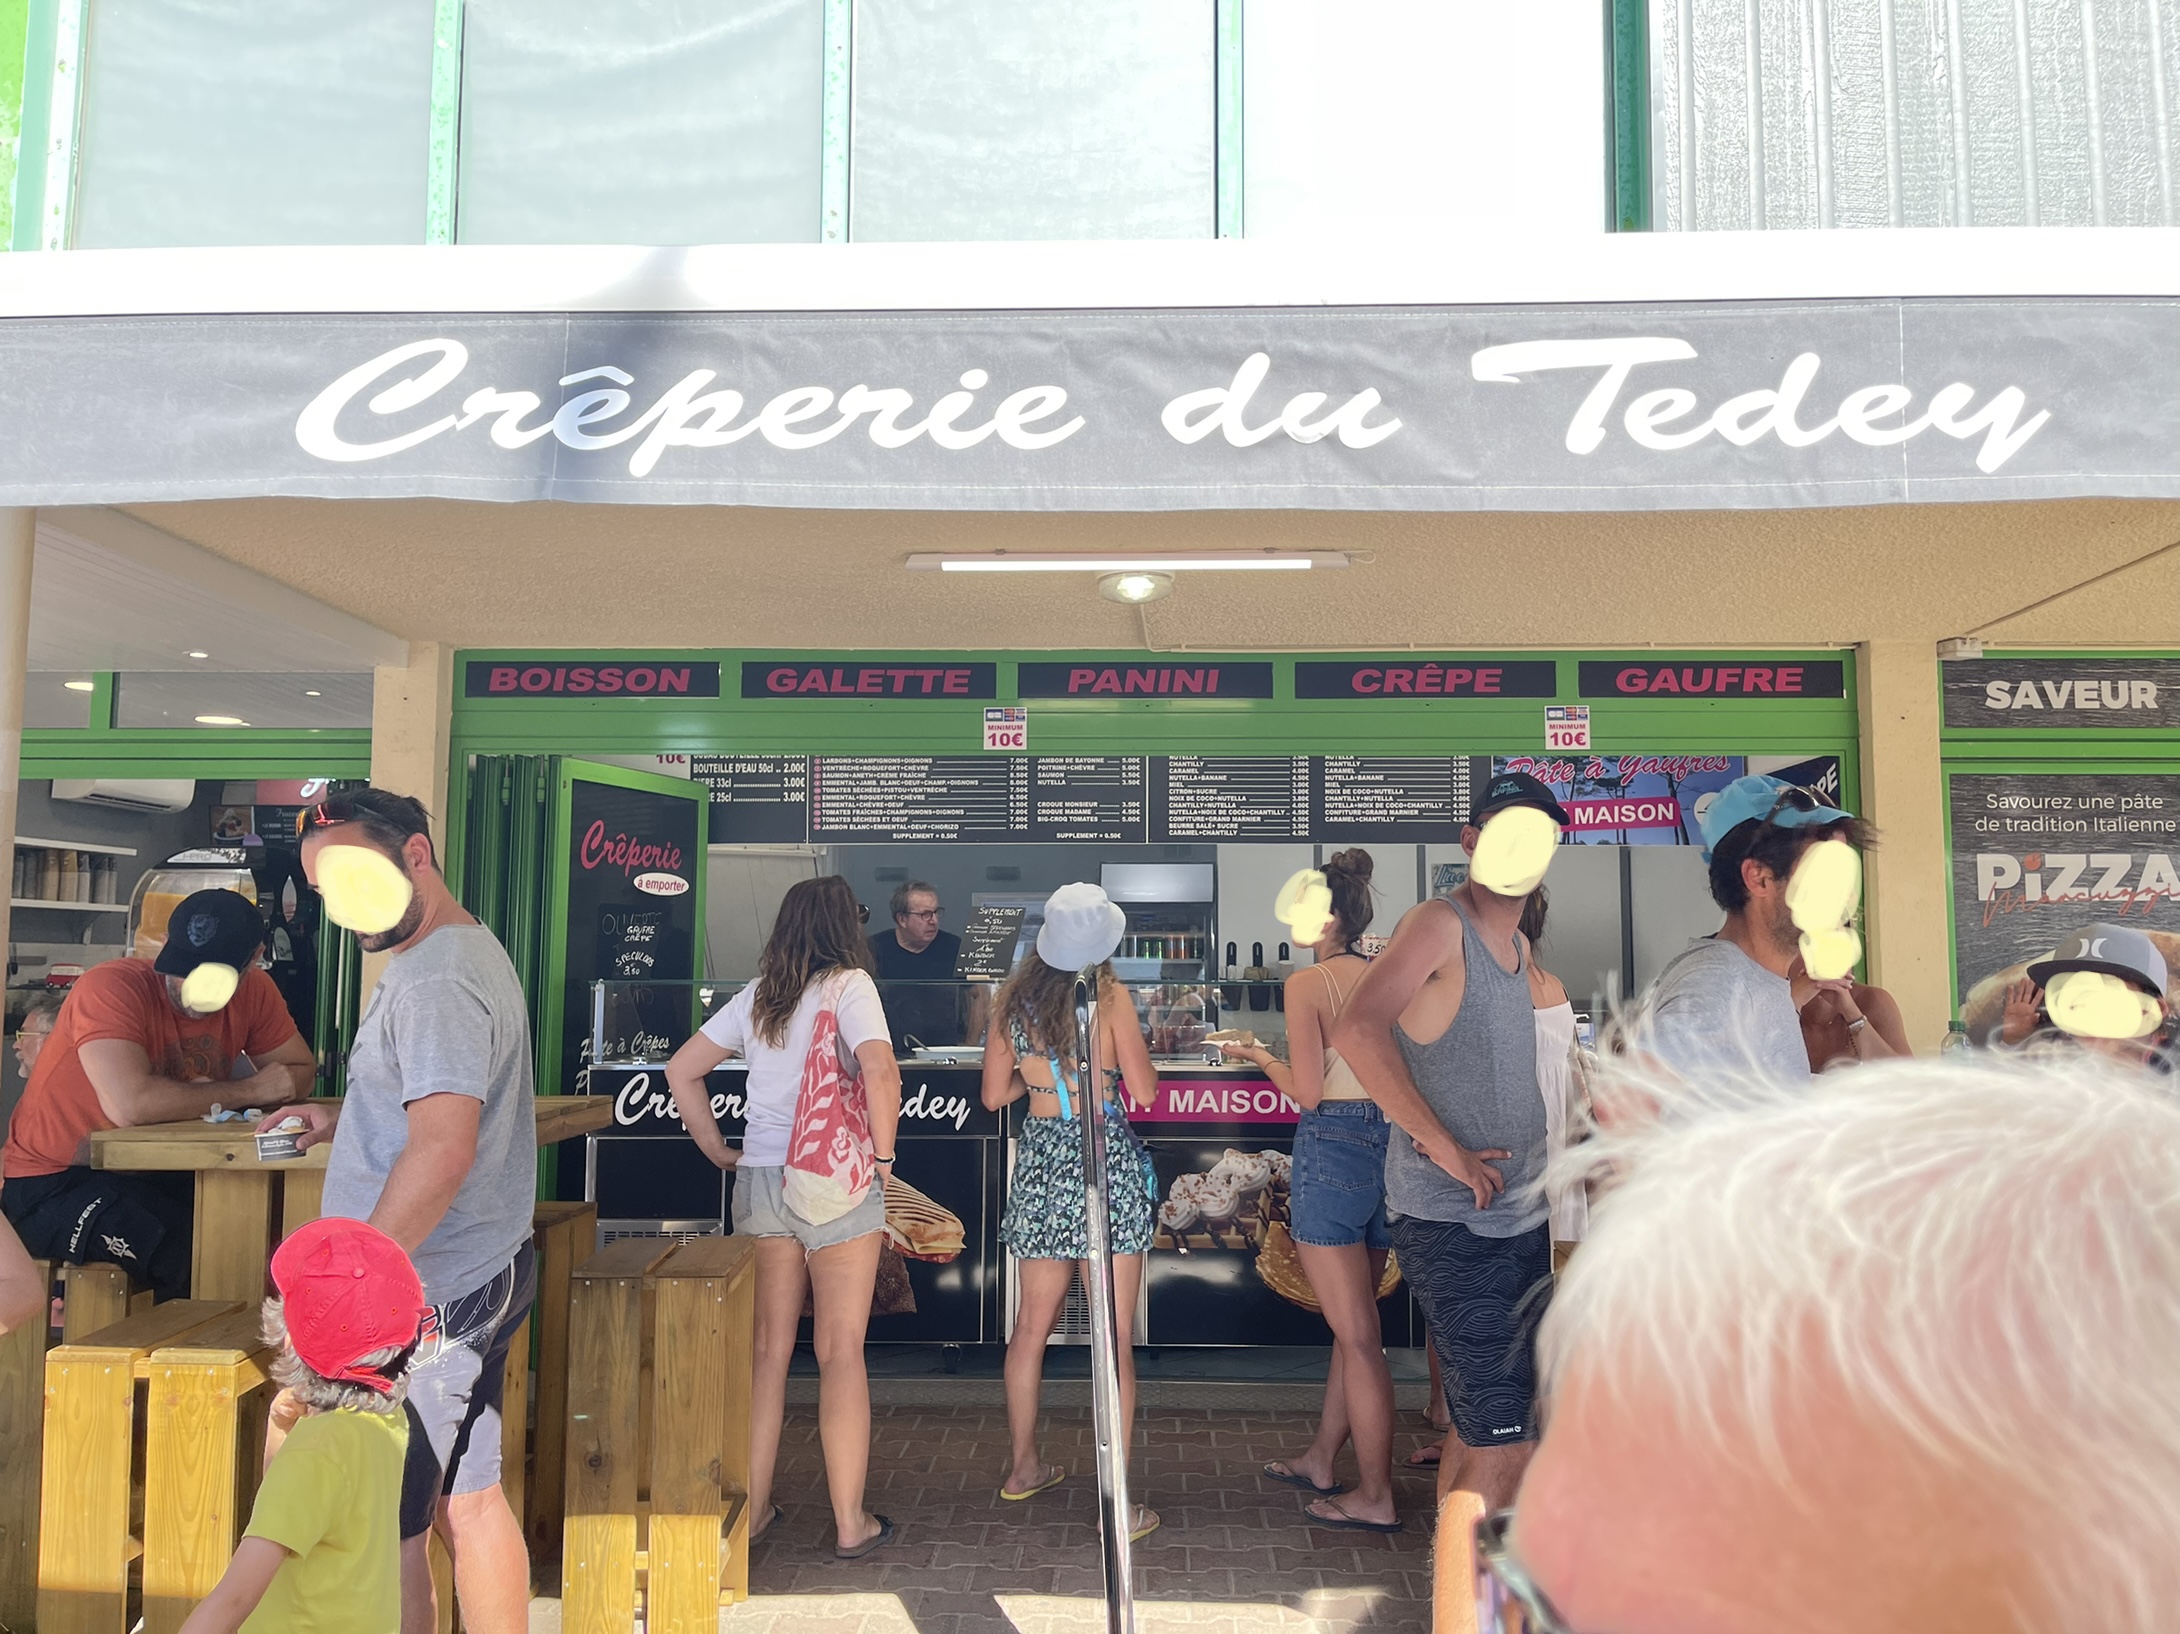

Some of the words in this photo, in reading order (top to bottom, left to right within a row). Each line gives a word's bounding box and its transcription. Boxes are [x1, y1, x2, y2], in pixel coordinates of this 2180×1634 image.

[295, 338, 1087, 478] Crêperie
[1161, 352, 1403, 450] du
[1470, 337, 2051, 475] Tedey
[488, 668, 690, 693] BOISSON
[766, 669, 970, 694] GALETTE
[1067, 668, 1220, 693] PANINI
[1351, 664, 1503, 693] CRÊPE
[1615, 667, 1803, 693] GAUFRE
[1985, 680, 2159, 709] SAVEUR
[988, 732, 1024, 747] 10€
[1549, 731, 1585, 746] 10€
[693, 763, 734, 774] BOUTEILLE
[735, 763, 757, 774] D'EAU
[783, 763, 805, 774] 2.00€
[1506, 756, 1575, 785] Pâte
[1584, 756, 1607, 779] à
[1618, 756, 1732, 786] Gaufres
[783, 777, 805, 788] 3.00€
[783, 792, 805, 803] 3.00€
[1986, 794, 2073, 809] Savourez
[2078, 796, 2115, 809] une
[2121, 793, 2164, 812] pâte
[1574, 803, 1674, 825] MAISON
[1975, 816, 2000, 832] de
[2006, 816, 2088, 832] tradition
[2094, 816, 2177, 832] Italienne
[580, 819, 683, 877] Crêperie
[637, 877, 644, 889] à
[645, 879, 686, 892] emporter
[624, 933, 653, 942] CRÊPE
[627, 925, 656, 935] GAUFRE
[616, 951, 655, 968] SPECULOOS
[617, 1037, 627, 1055] à
[631, 1030, 671, 1055] Crêpes
[1169, 1089, 1301, 1114] MAISON
[69, 1197, 102, 1254] HELLFEST
[1492, 1427, 1515, 1435] OLAIAN
